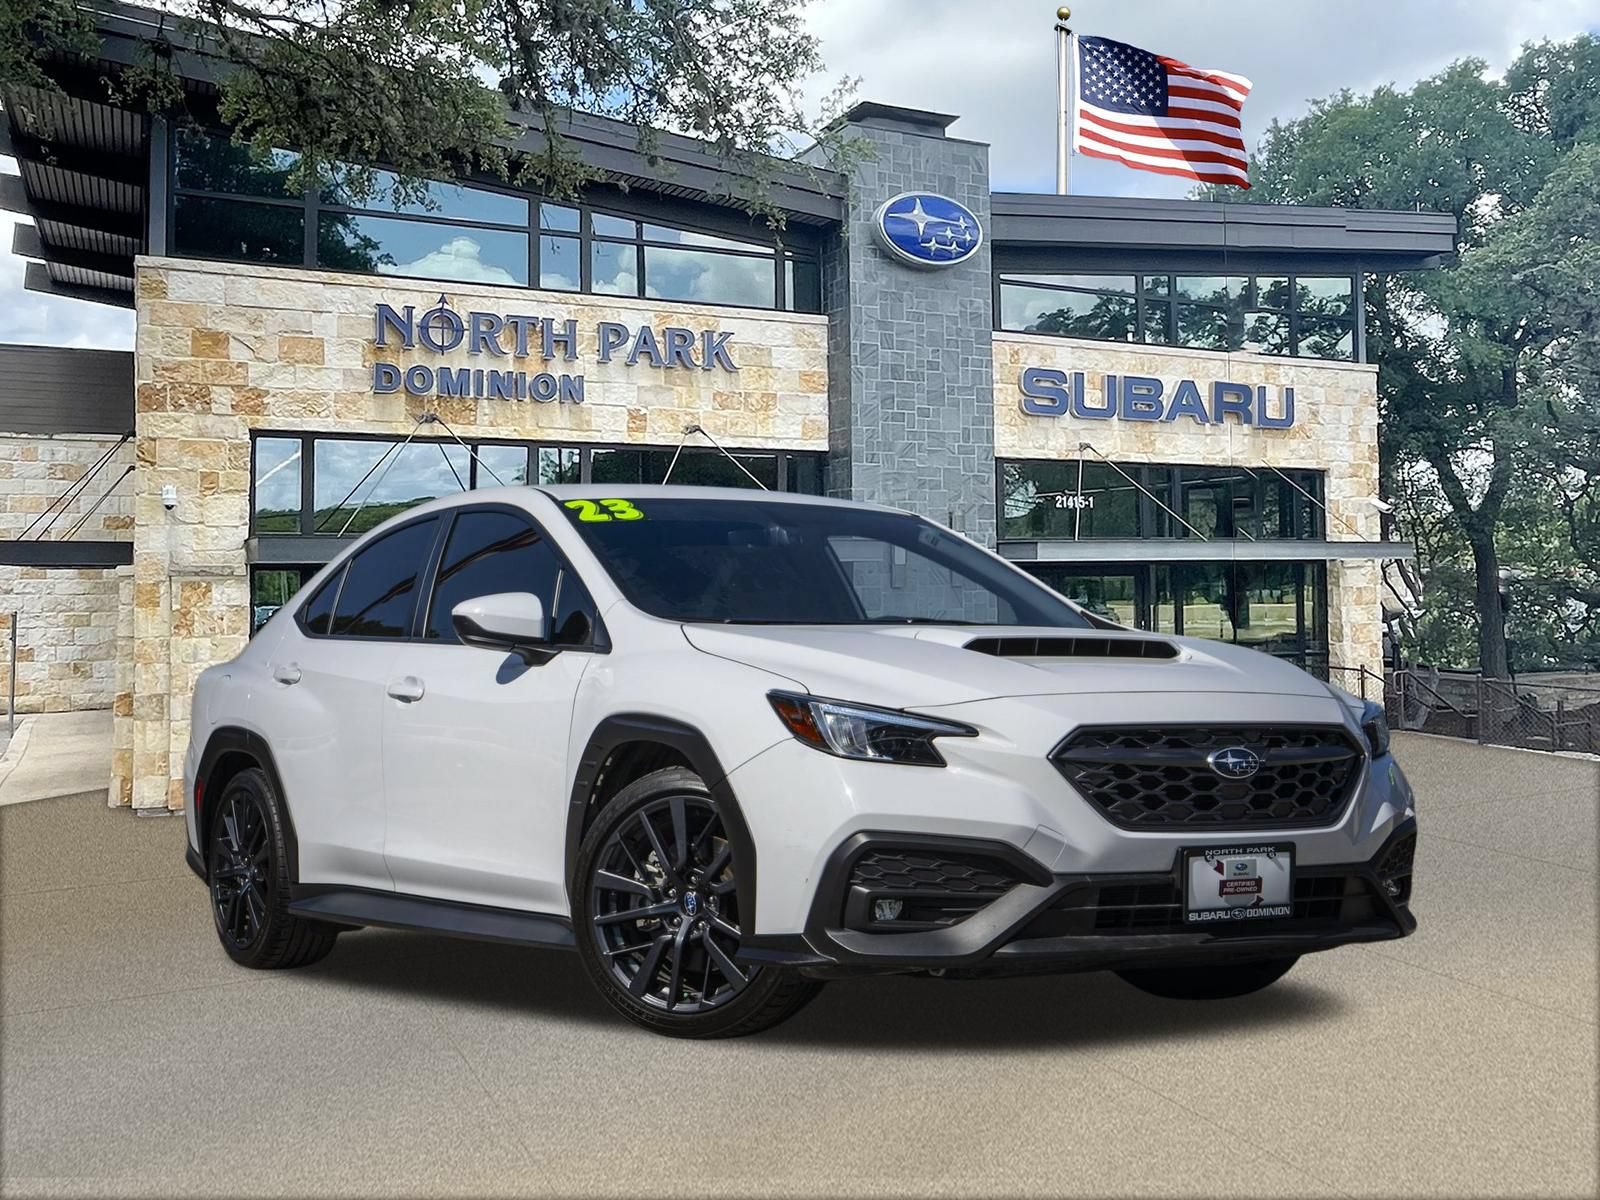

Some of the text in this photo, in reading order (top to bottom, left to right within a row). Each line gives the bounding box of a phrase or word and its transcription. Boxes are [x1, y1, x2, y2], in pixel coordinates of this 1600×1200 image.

[374, 294, 740, 372] NORTH PARK
[373, 362, 584, 404] DOMINION
[1019, 367, 1295, 430] SUBARU
[564, 499, 644, 521] 23
[1188, 906, 1291, 921] SUBARU DOMINION
